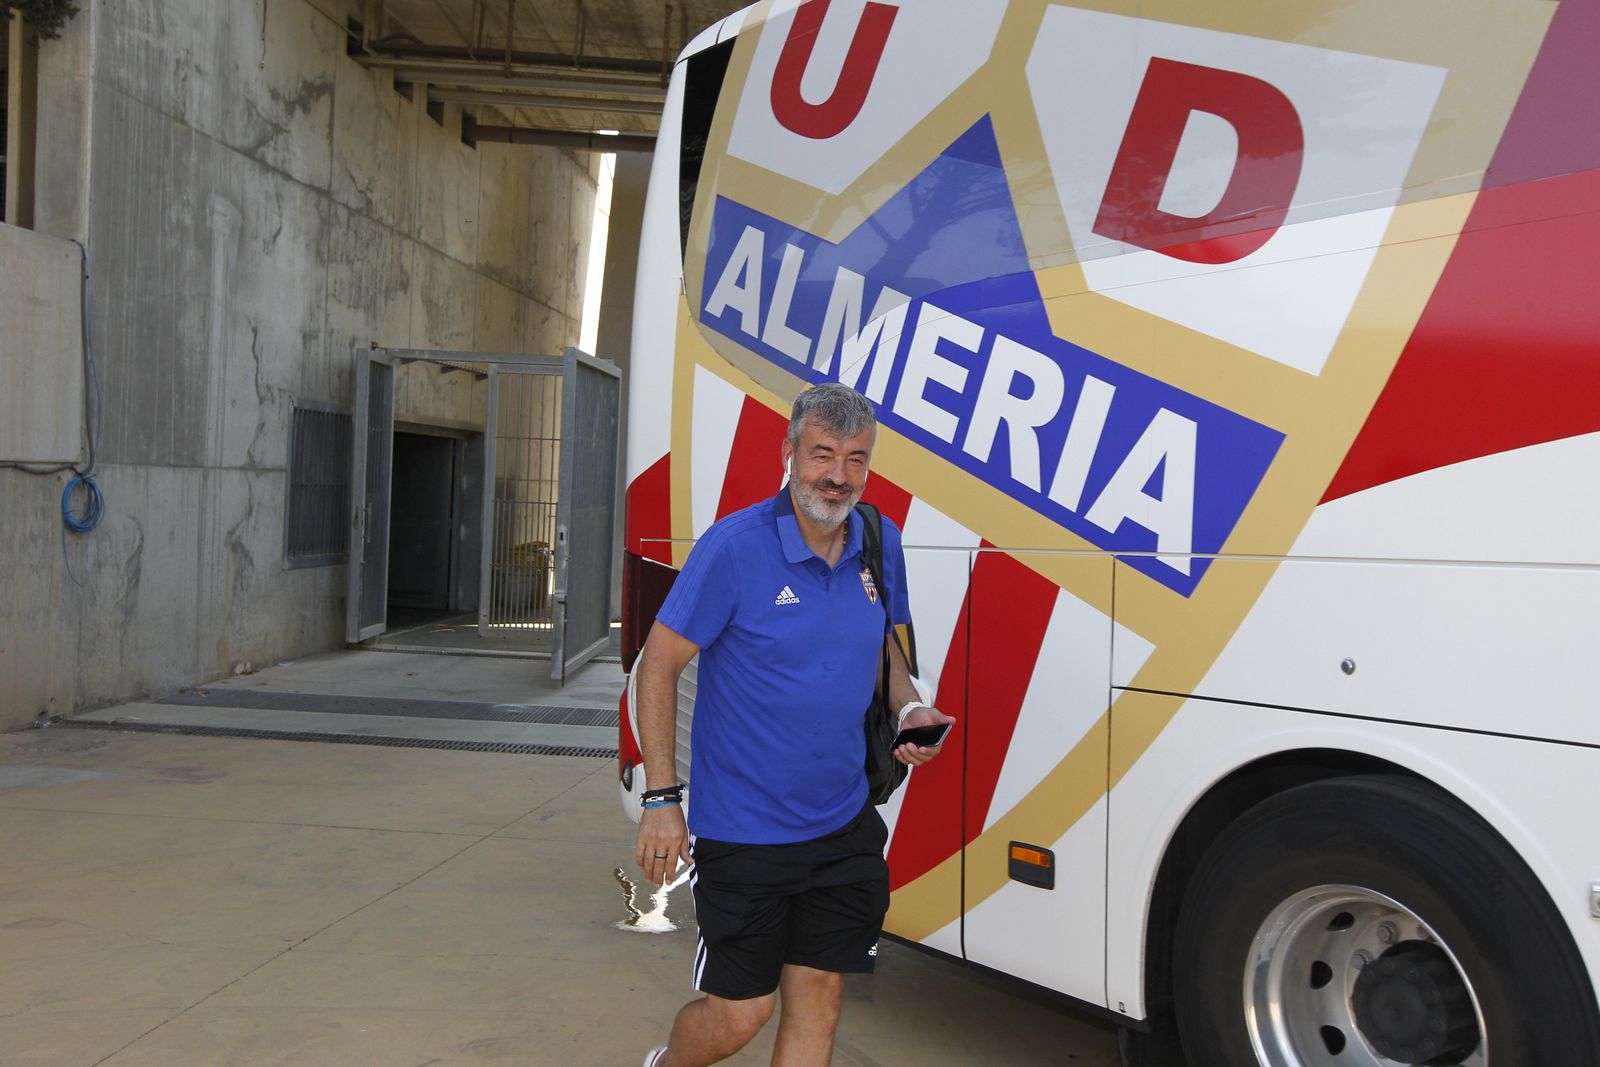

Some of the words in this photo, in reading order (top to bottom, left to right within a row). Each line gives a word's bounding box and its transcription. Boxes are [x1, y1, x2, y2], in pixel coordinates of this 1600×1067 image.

[770, 0, 899, 139] U
[1092, 56, 1304, 265] D
[705, 224, 1198, 577] ALMERIA
[774, 597, 801, 606] adidas
